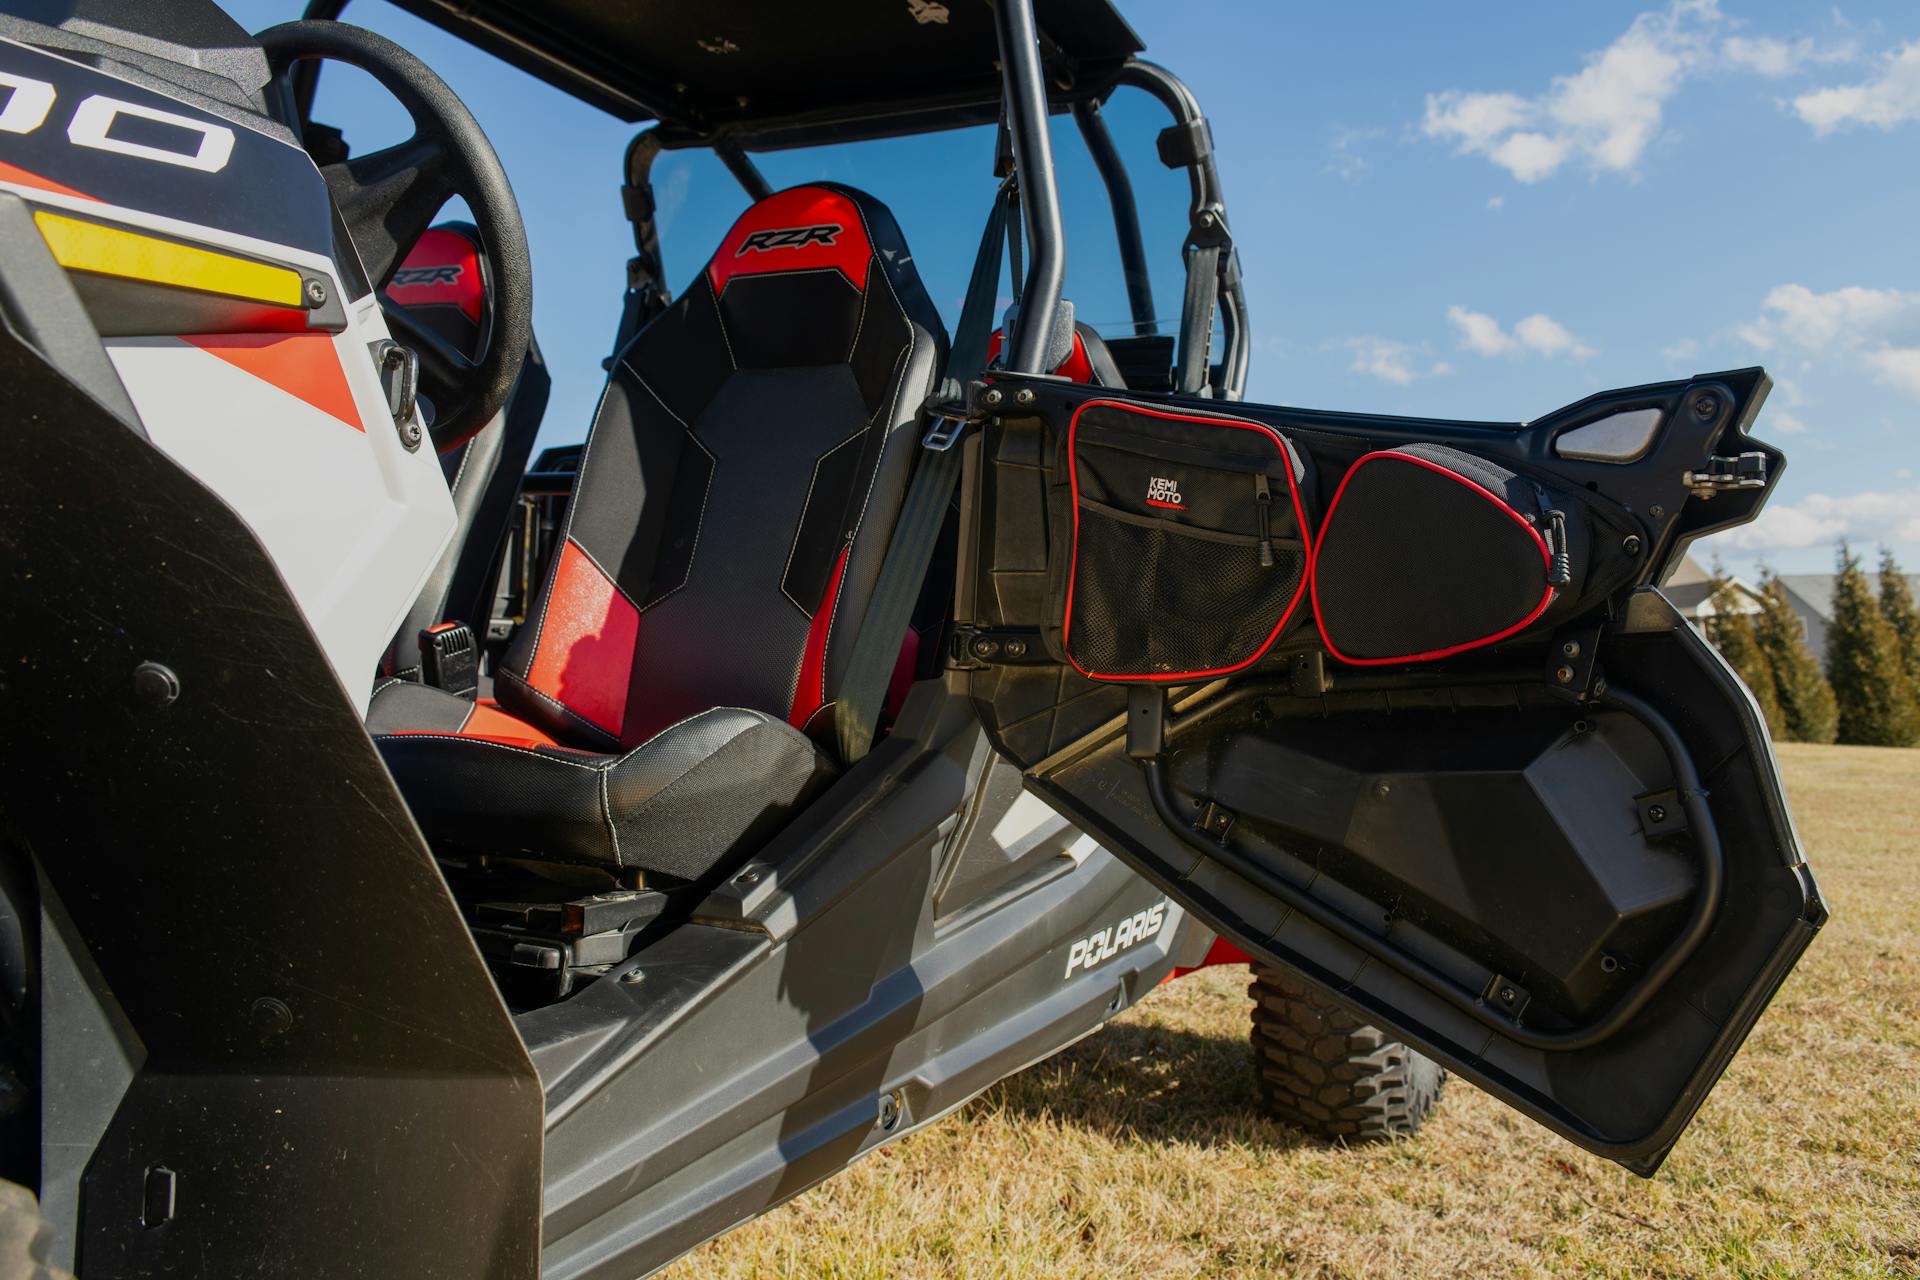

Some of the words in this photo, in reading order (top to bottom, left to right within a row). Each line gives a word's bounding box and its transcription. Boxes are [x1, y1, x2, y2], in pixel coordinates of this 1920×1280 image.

[736, 223, 844, 257] RZR
[1147, 488, 1181, 504] MOTO
[1150, 477, 1177, 492] KEMI
[1064, 902, 1165, 979] POLARIS
